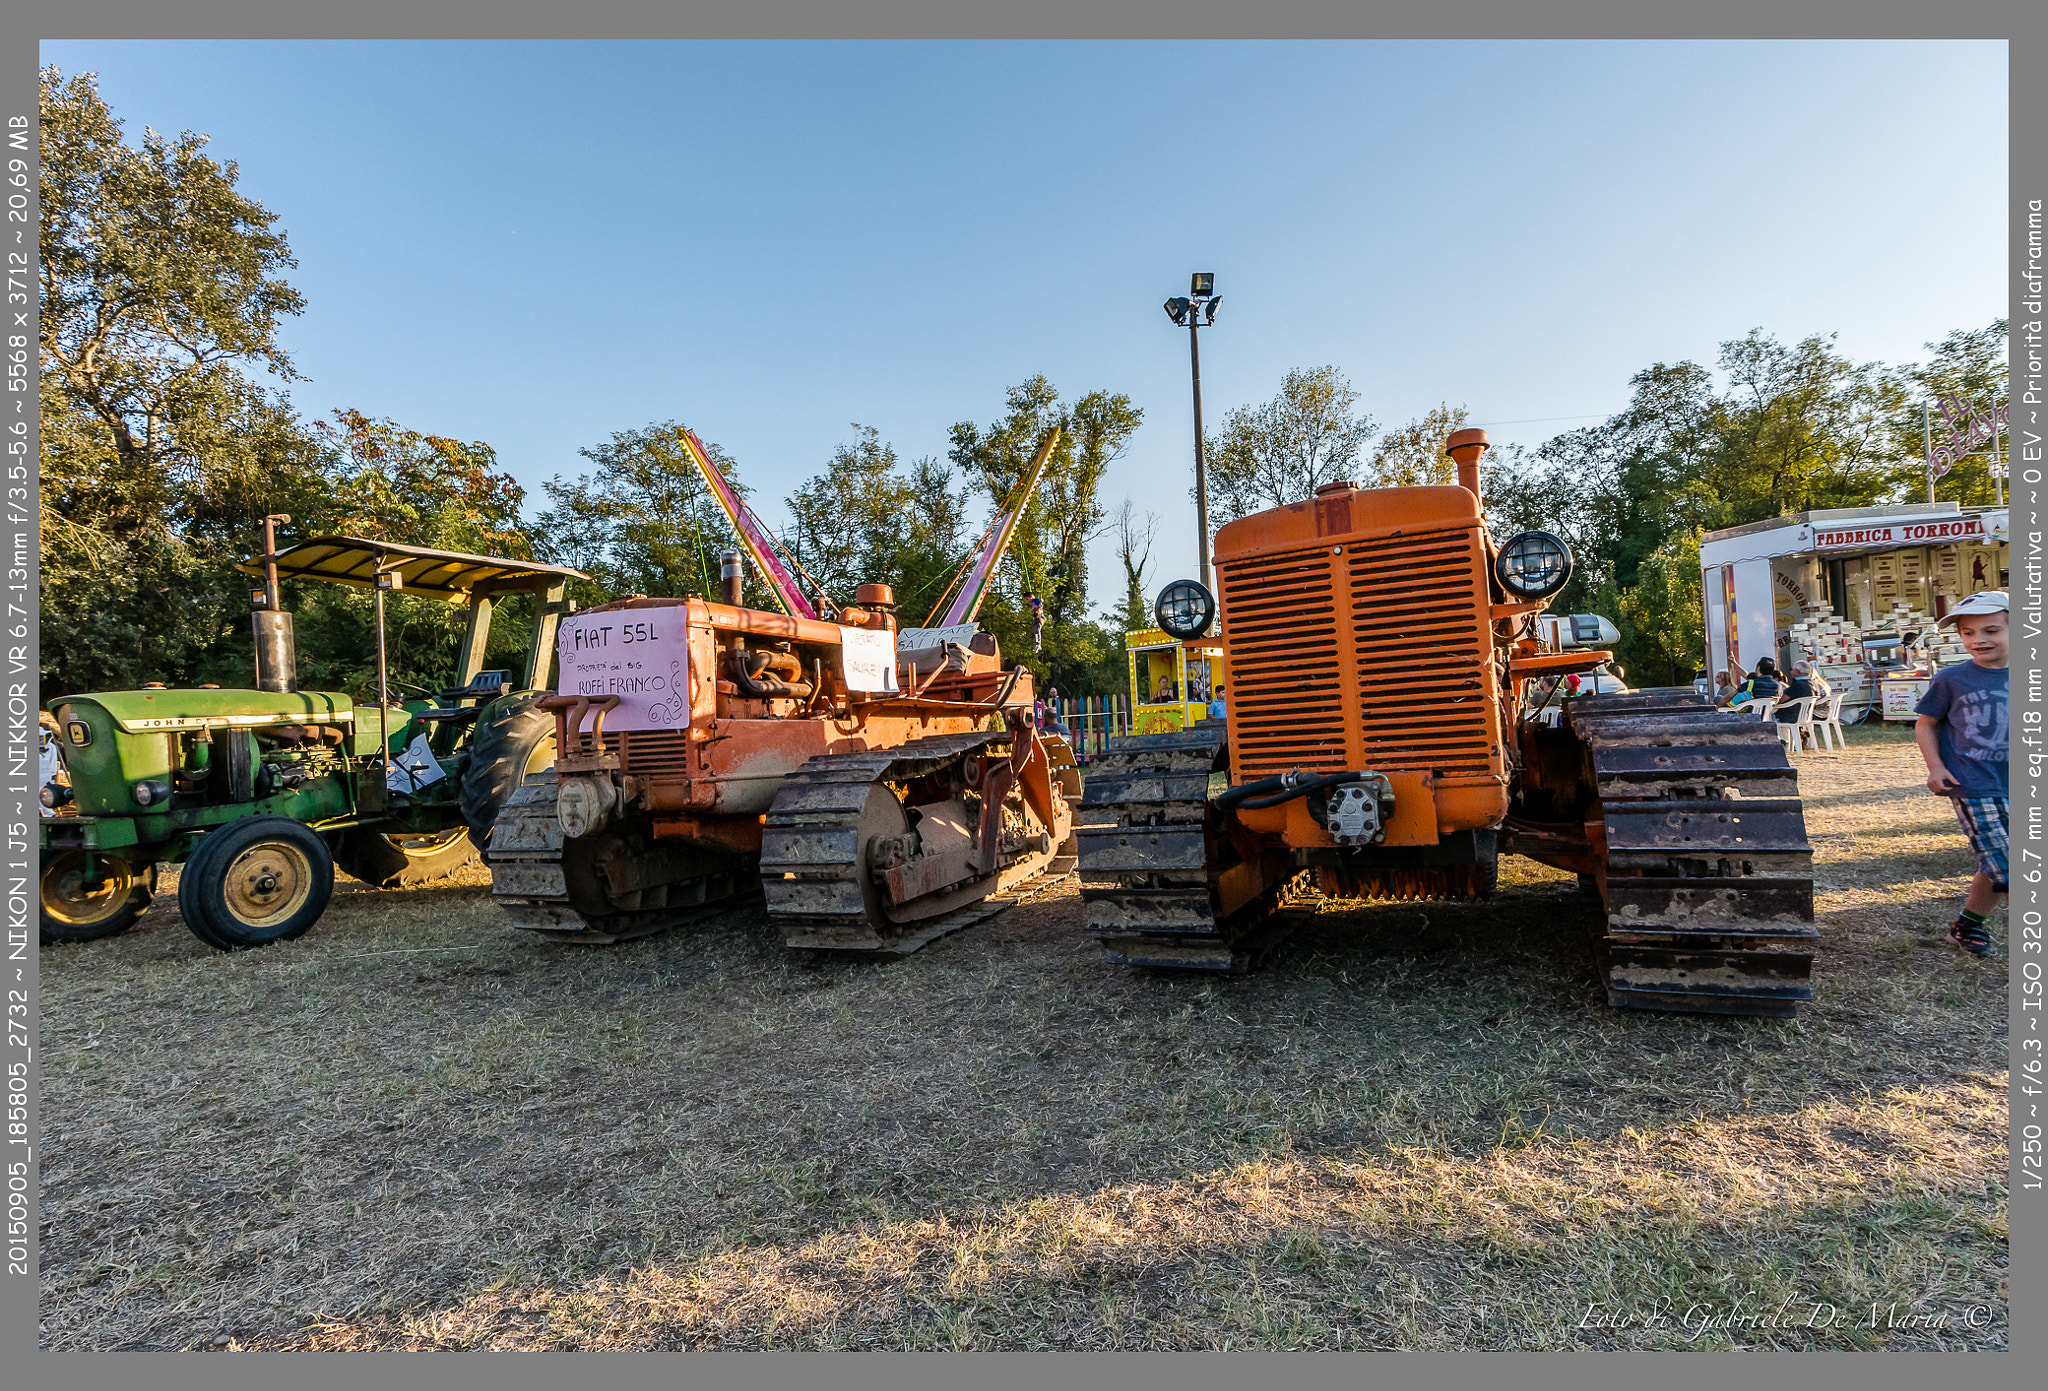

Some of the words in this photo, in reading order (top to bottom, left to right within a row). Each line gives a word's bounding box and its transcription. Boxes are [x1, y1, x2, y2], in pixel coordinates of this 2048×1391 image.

[1817, 529, 1892, 546] FABBRICA
[574, 627, 612, 651] FIAT
[623, 623, 658, 644] 55L
[904, 625, 974, 639] VIETATO
[610, 676, 666, 693] FRANCO
[144, 718, 185, 727] JOHN
